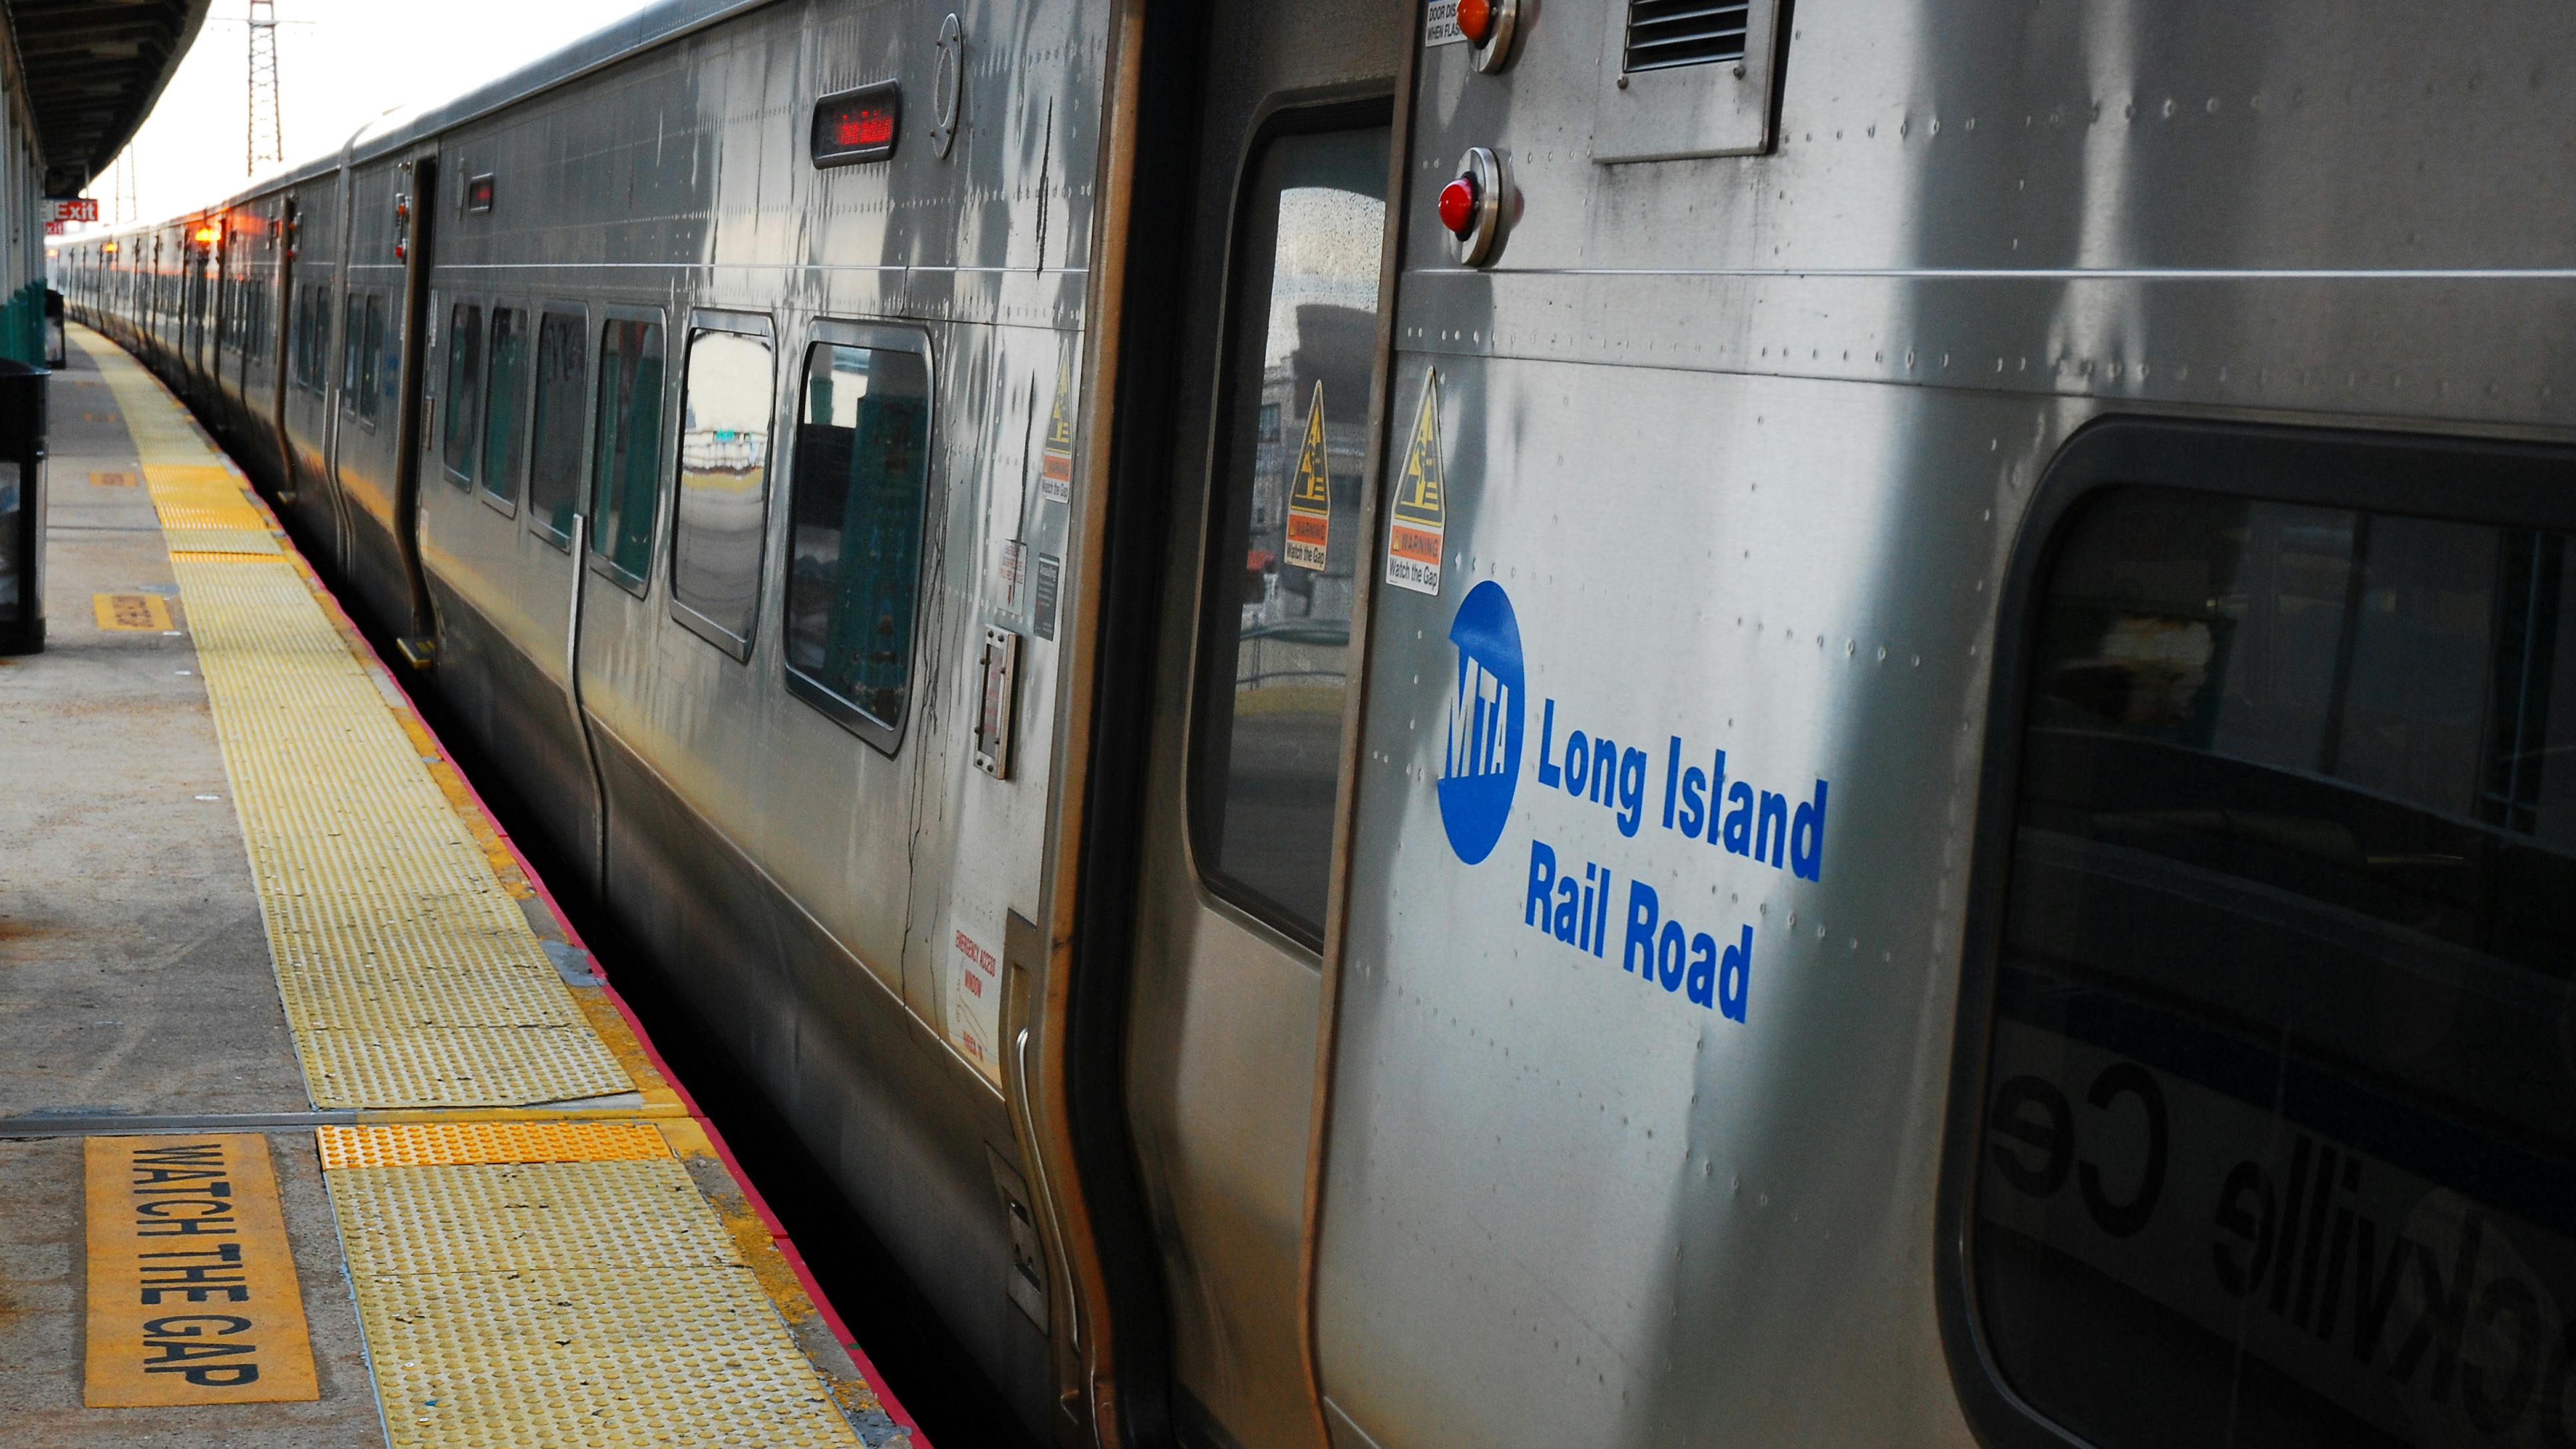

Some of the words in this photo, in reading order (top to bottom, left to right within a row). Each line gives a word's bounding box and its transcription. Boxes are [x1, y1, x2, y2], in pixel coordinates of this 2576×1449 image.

[1427, 25, 1443, 41] WHEN
[1429, 5, 1445, 21] DOOR
[55, 202, 95, 220] Exit
[1287, 542, 1303, 560] Watch
[1303, 545, 1312, 562] the
[1313, 547, 1325, 568] Gap
[1402, 532, 1438, 558] WARNING
[1390, 558, 1410, 579] Watch
[1411, 564, 1422, 583] the
[1424, 565, 1438, 590] Gap
[1438, 643, 1509, 781] MTA
[1538, 698, 1647, 838] Long
[1662, 735, 1828, 883] Island
[1524, 839, 1611, 959] Rail
[1623, 880, 1753, 1025] Road
[133, 1144, 236, 1237] WATCH
[138, 1243, 249, 1305] THE
[143, 1315, 259, 1387] GAP
